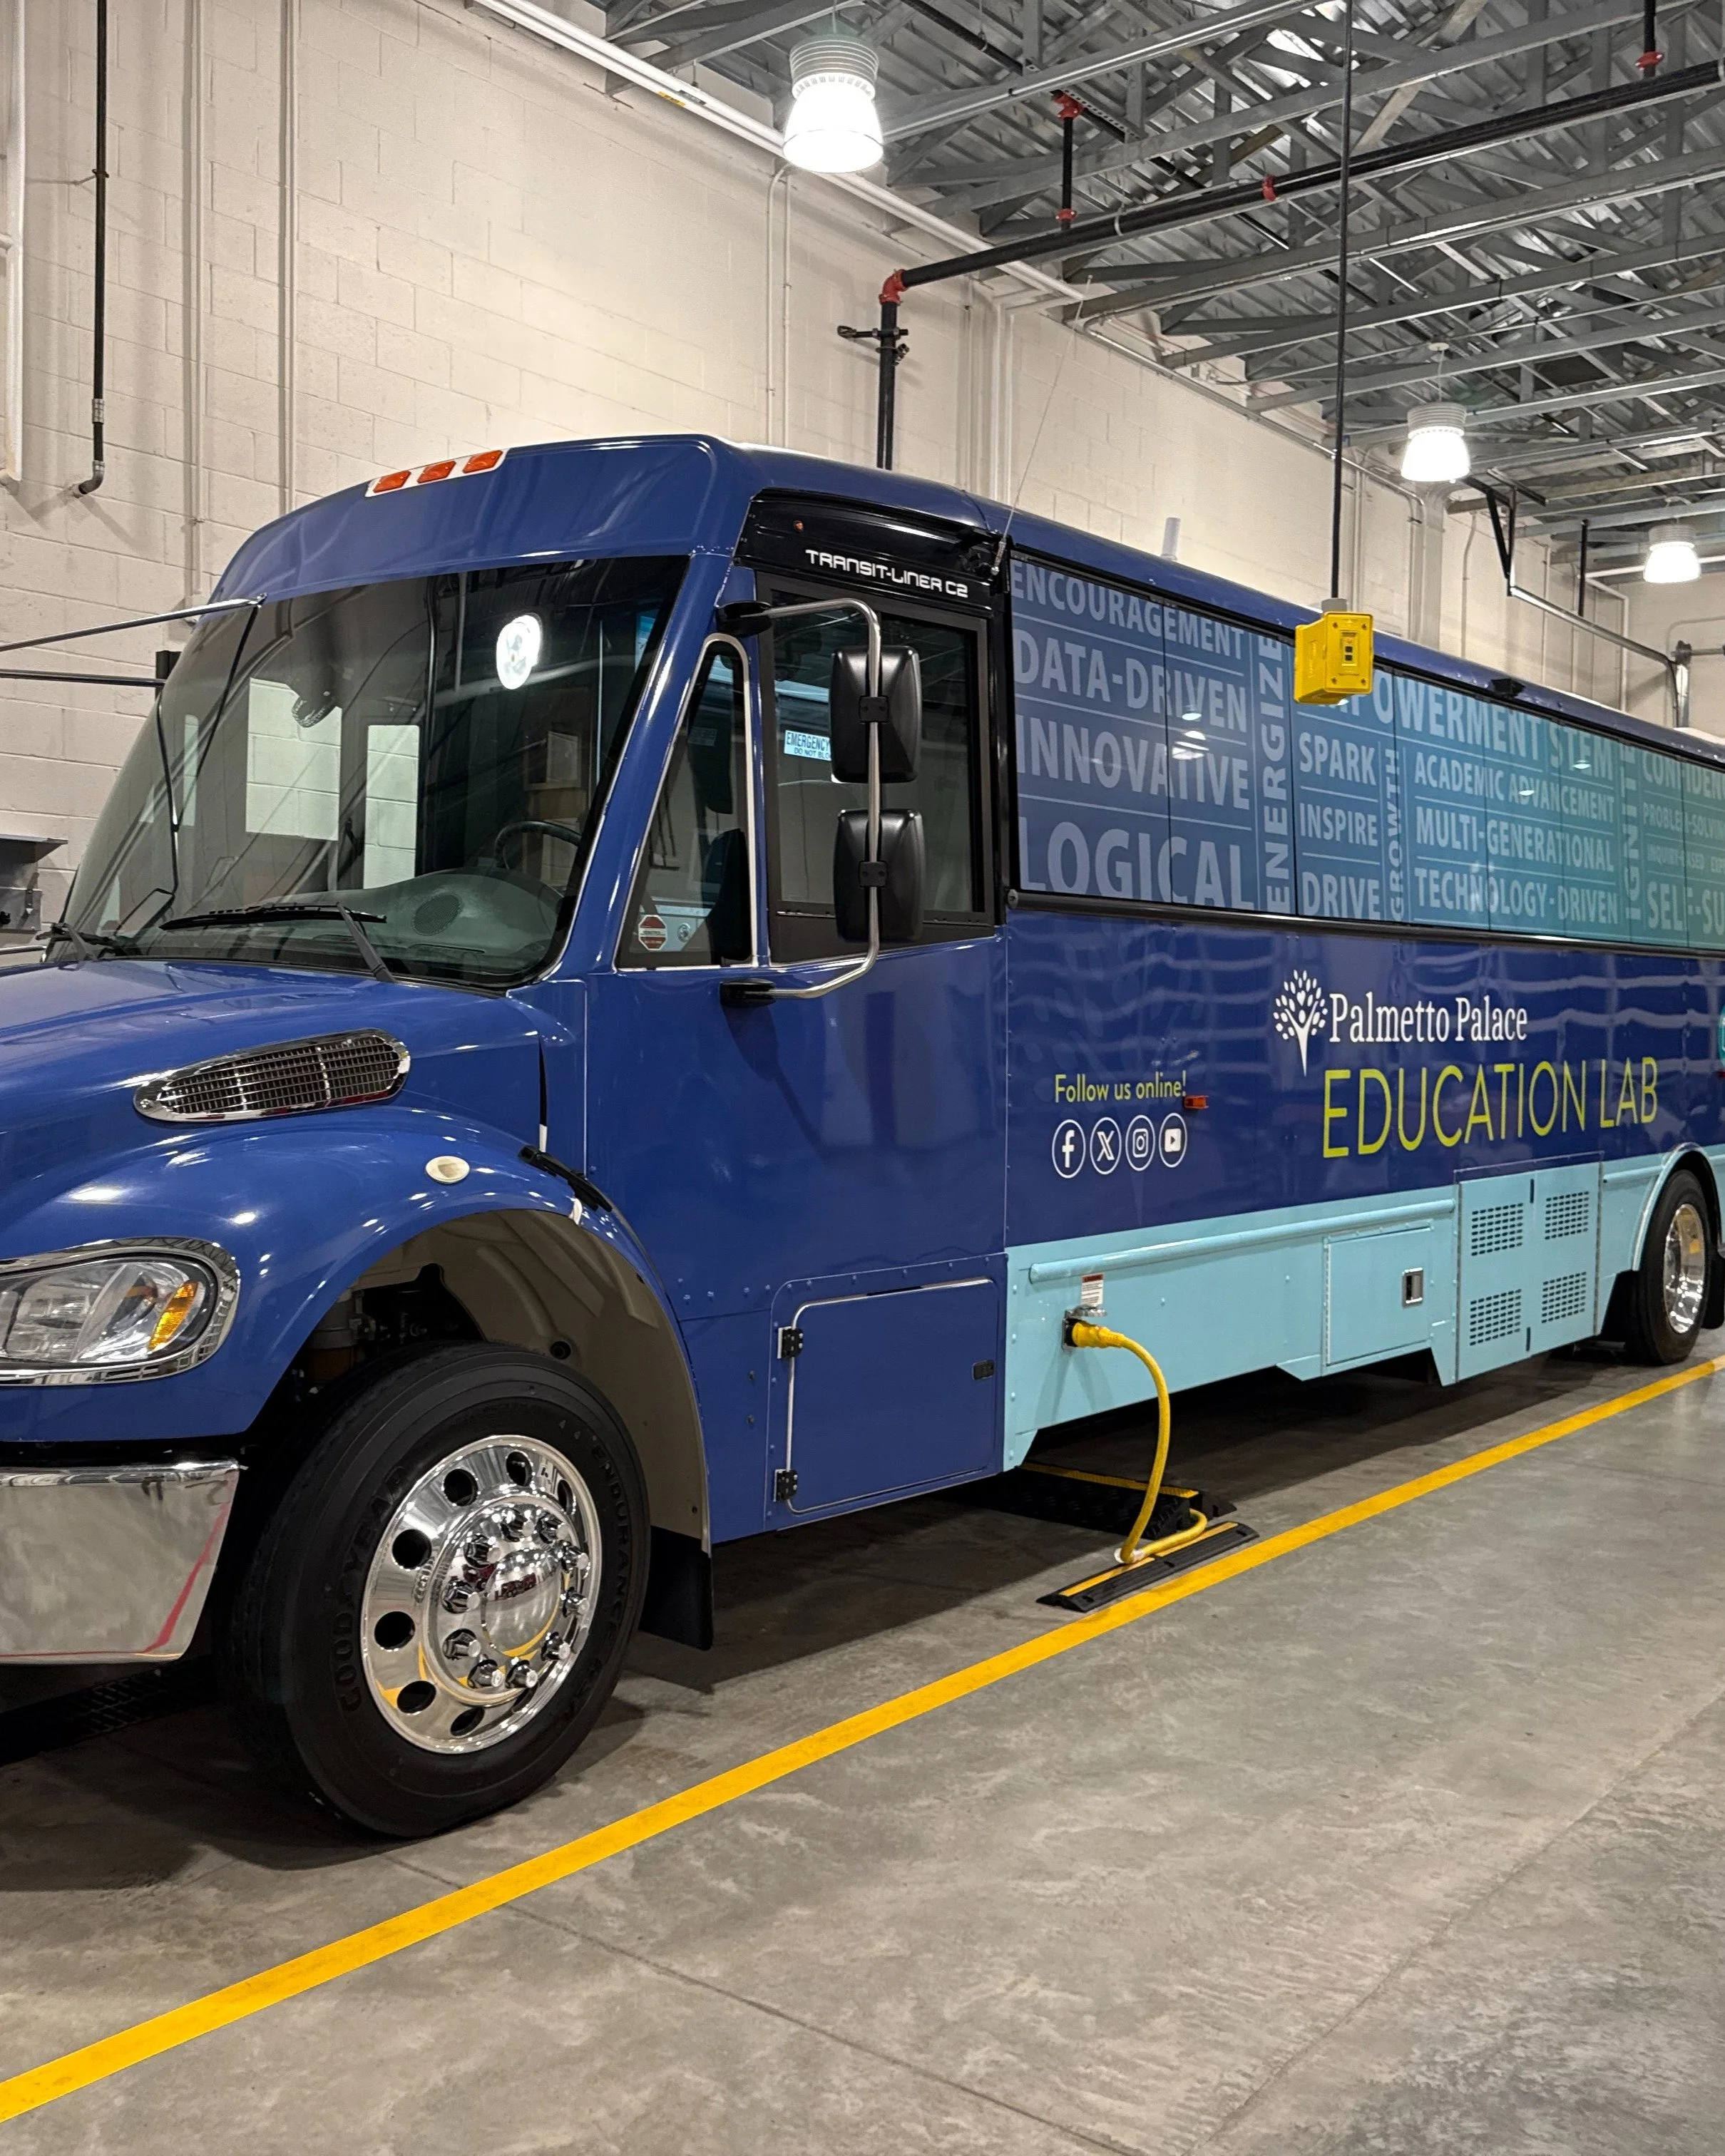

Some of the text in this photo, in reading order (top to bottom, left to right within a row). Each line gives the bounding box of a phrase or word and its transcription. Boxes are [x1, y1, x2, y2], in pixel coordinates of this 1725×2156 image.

[805, 549, 968, 598] TRANSIT-LINER C2
[1010, 560, 1244, 659] ENCOURAGEMENT
[1013, 629, 1247, 732] DATA-DRIVEN
[787, 732, 830, 751] EMERGENCY
[1015, 714, 1250, 810] INNOVATIVE
[1259, 635, 1291, 913] ENERGIZE
[1298, 732, 1377, 786] SPARK
[1549, 719, 1613, 781] STEM
[1414, 751, 1615, 823] ACADEMIC ADVANCEMENT
[1299, 802, 1379, 847] INSPIRE
[1384, 748, 1404, 922] GROWTH
[1416, 806, 1614, 873] MULTI-GENERATIONAL
[1018, 816, 1255, 910] LOGICAL
[1301, 871, 1381, 920] DRIVE
[1329, 991, 1528, 1044] Palmetto Palace
[1055, 1069, 1187, 1103] Follow us online!
[1323, 1057, 1658, 1159] EDUCATION LAB
[332, 1465, 408, 1712] GOODYEAR
